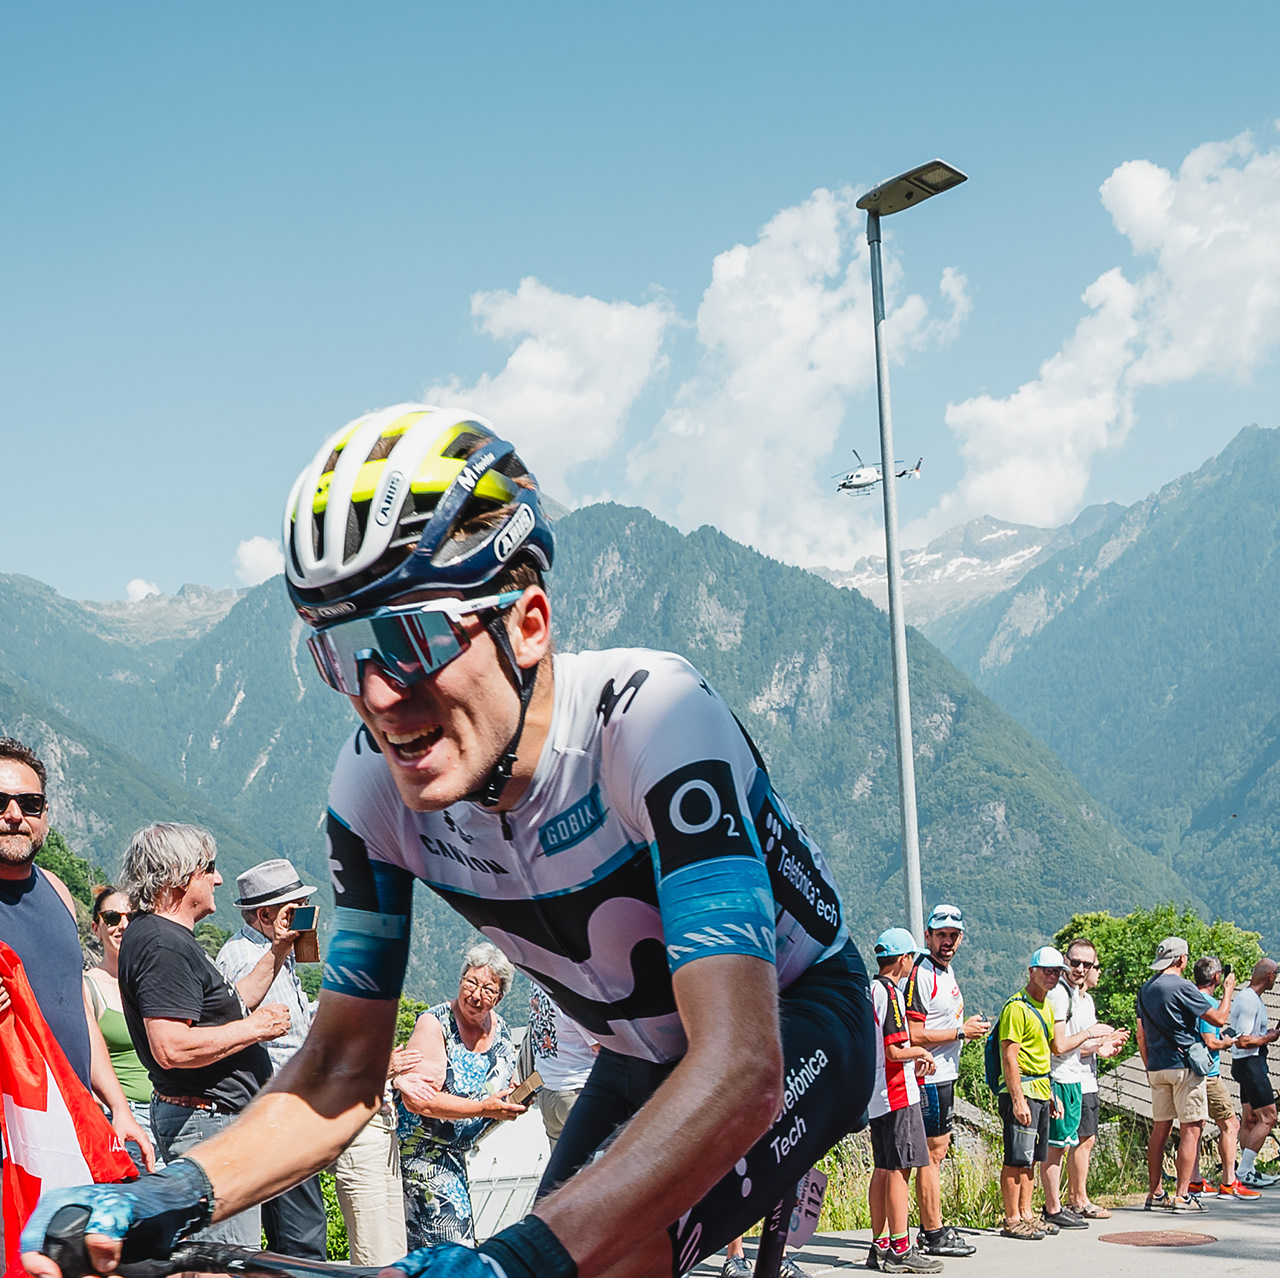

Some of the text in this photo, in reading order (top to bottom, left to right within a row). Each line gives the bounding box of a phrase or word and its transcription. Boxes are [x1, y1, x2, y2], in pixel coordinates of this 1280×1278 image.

[545, 803, 596, 845] GOBIK
[769, 1114, 807, 1164] Tech
[804, 1181, 825, 1219] 112
